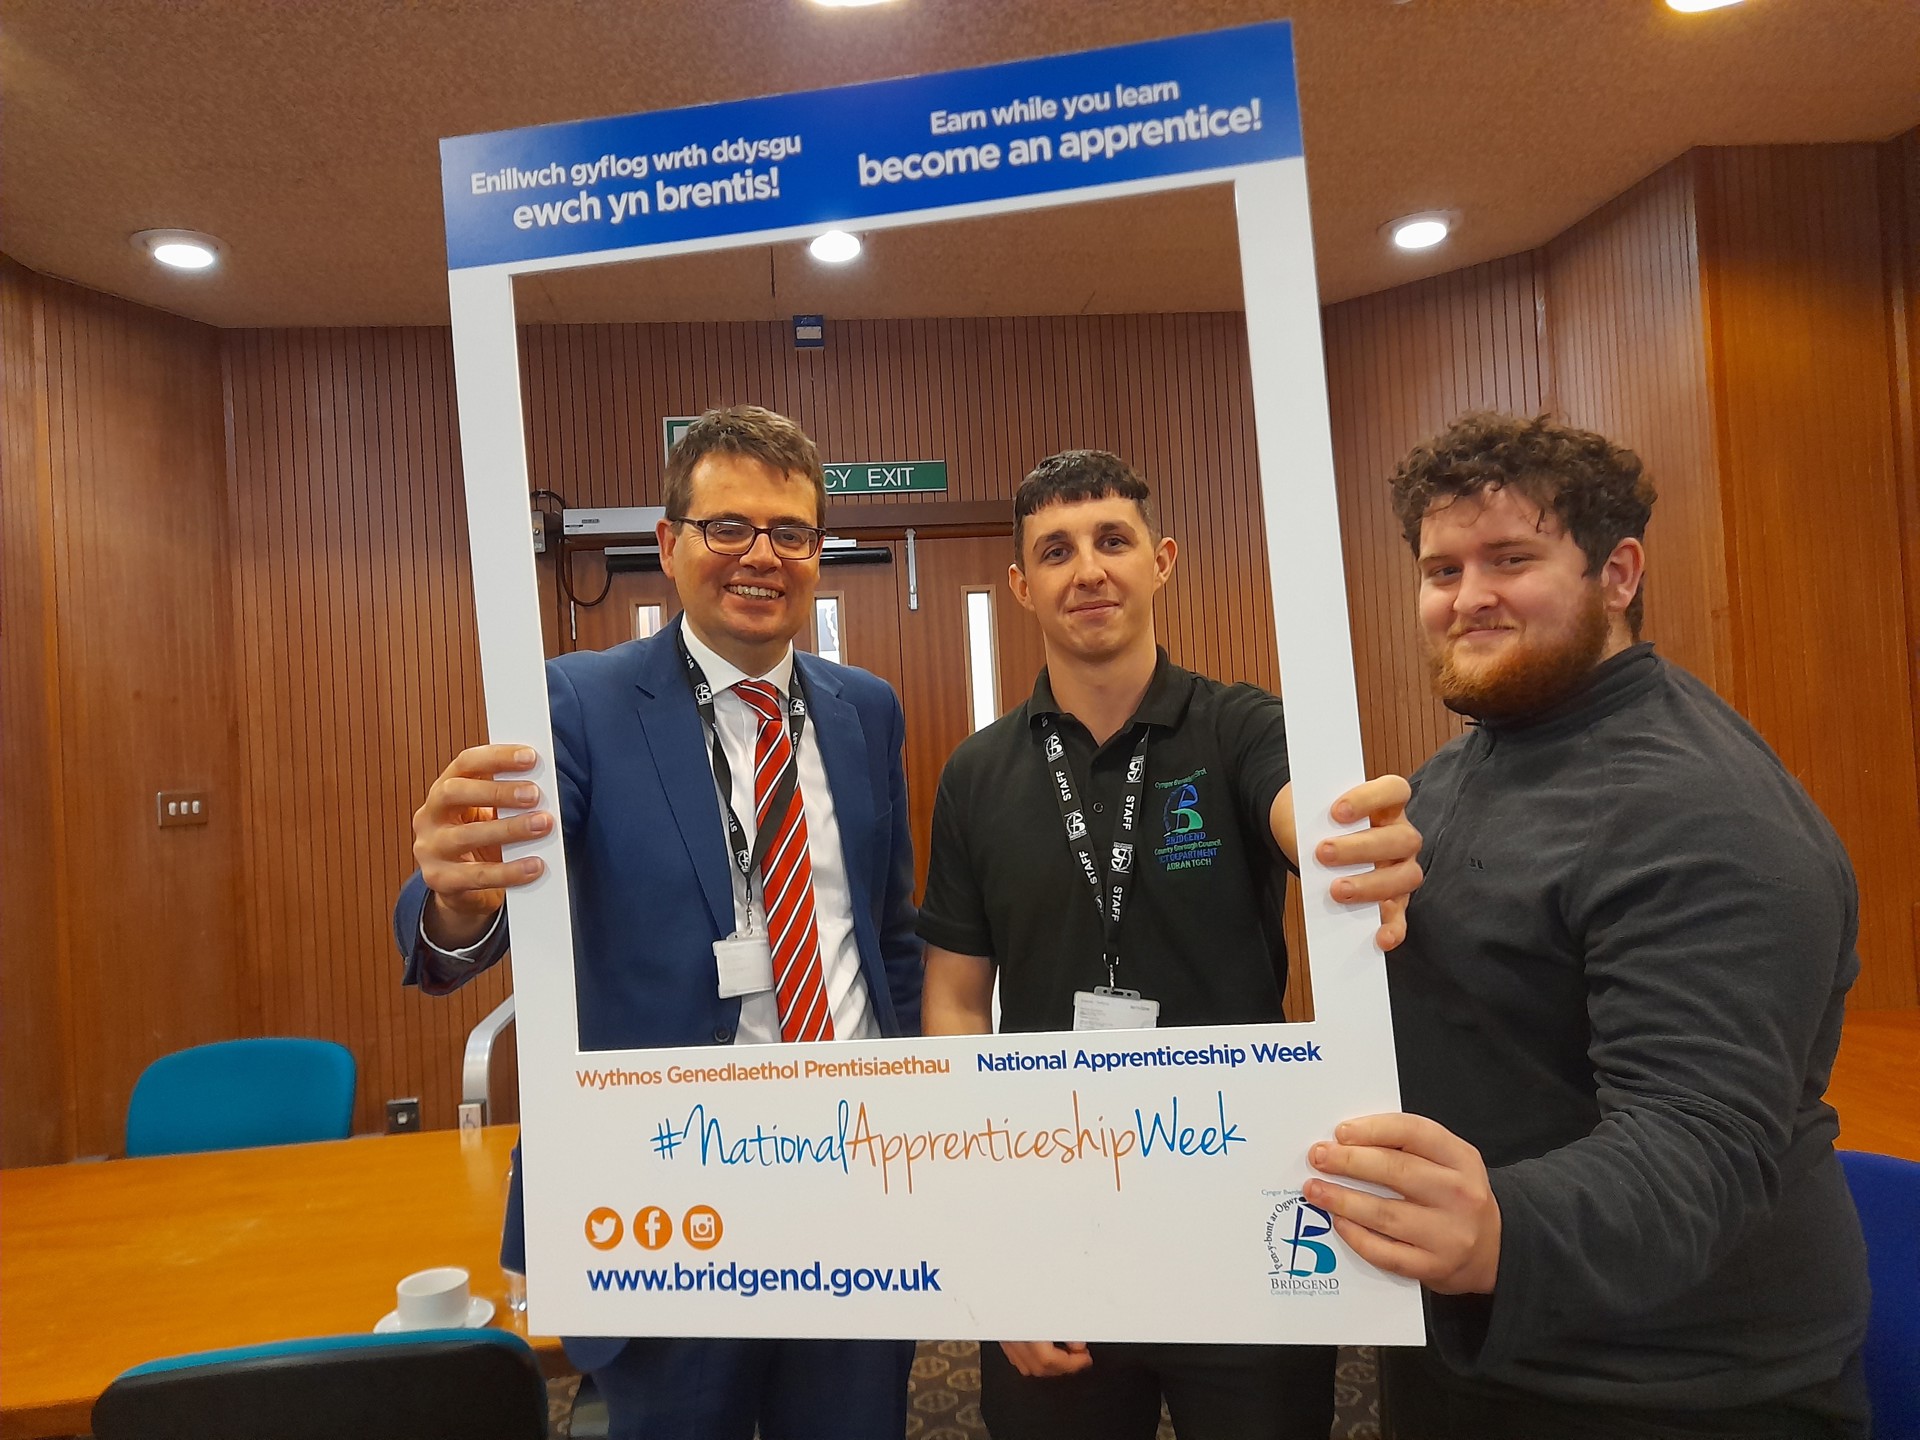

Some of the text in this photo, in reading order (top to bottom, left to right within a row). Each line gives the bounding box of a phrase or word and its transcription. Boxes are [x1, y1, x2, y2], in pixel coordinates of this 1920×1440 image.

[930, 79, 1180, 135] Earn while you learn
[857, 98, 1263, 187] become an apprentice!
[470, 133, 802, 195] Enillwch gyflog wrth ddysgu
[512, 166, 781, 230] ewch yn brentis!
[867, 467, 915, 488] EXIT
[1055, 770, 1072, 802] STAFF
[1122, 795, 1136, 831] STAFF
[1164, 831, 1206, 845] BRIDGEND
[1170, 847, 1217, 861] DEPARTMENT
[1078, 851, 1098, 884] STAFF
[1111, 886, 1123, 922] STAFF
[575, 1055, 951, 1090] Wythnos Genedlaethol Prentisiaethau
[977, 1041, 1322, 1072] National Apprenticeship Week
[650, 1090, 1247, 1195] #NationalApprenticeshipWeek
[1274, 1196, 1299, 1214] Ogwr
[586, 1261, 942, 1297] www.bridgend.gov.uk
